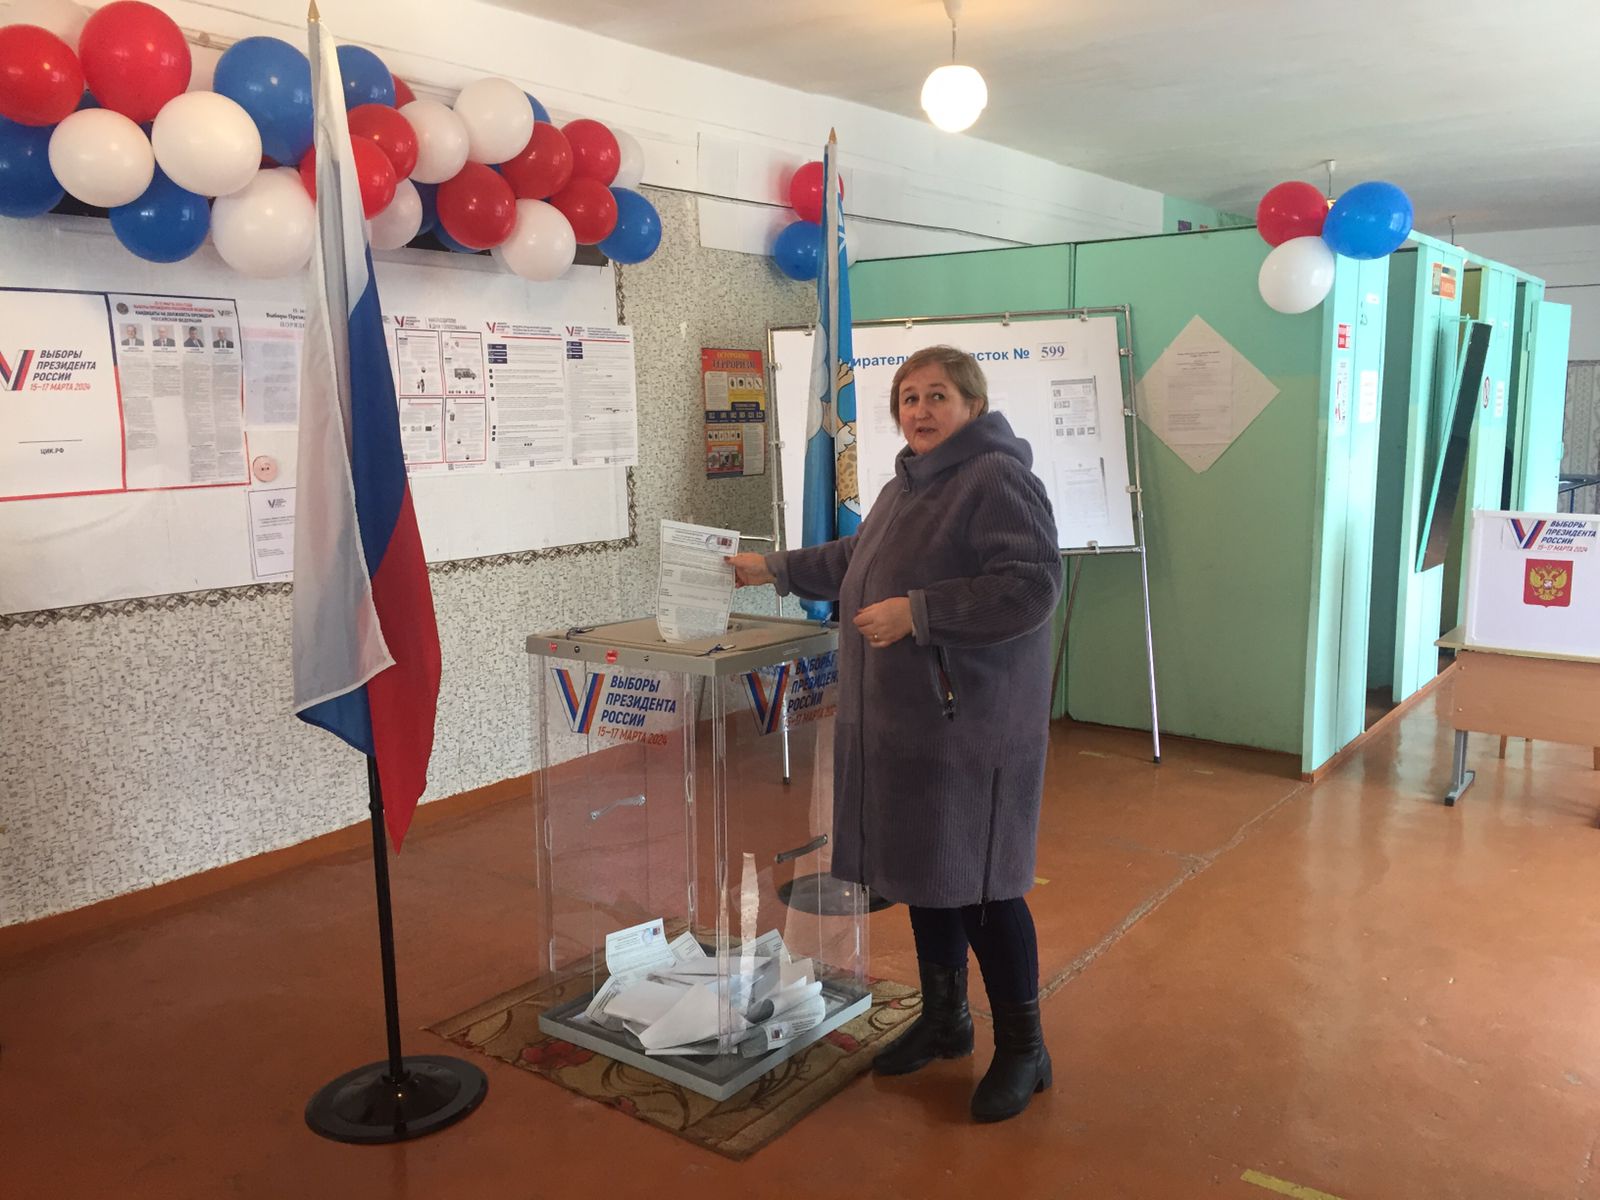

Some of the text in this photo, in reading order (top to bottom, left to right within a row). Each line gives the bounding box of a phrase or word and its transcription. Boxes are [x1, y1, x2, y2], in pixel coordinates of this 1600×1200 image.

[40, 350, 83, 359] ВЫБОРЫ
[1013, 347, 1030, 360] №
[1041, 345, 1065, 359] 599
[36, 361, 96, 371] ПРЕЗИДЕНТА
[33, 372, 72, 381] РОССИИ
[50, 383, 73, 391] МАРТА
[74, 382, 92, 391] 2024
[40, 447, 64, 455] ЦИК.РФ
[1550, 520, 1587, 528] ВЫБОРЫ
[1545, 529, 1597, 538] ПРЕЗИДЕНТА
[1541, 536, 1574, 545] РОССИИ
[610, 675, 661, 693] ВЫБОРЫ
[606, 692, 677, 713] ПРЕЗИДЕНТА
[787, 690, 824, 713] РОССИИ
[601, 709, 646, 728] РОССИИ
[619, 729, 647, 744] МАРТА
[648, 732, 668, 746] 2024
